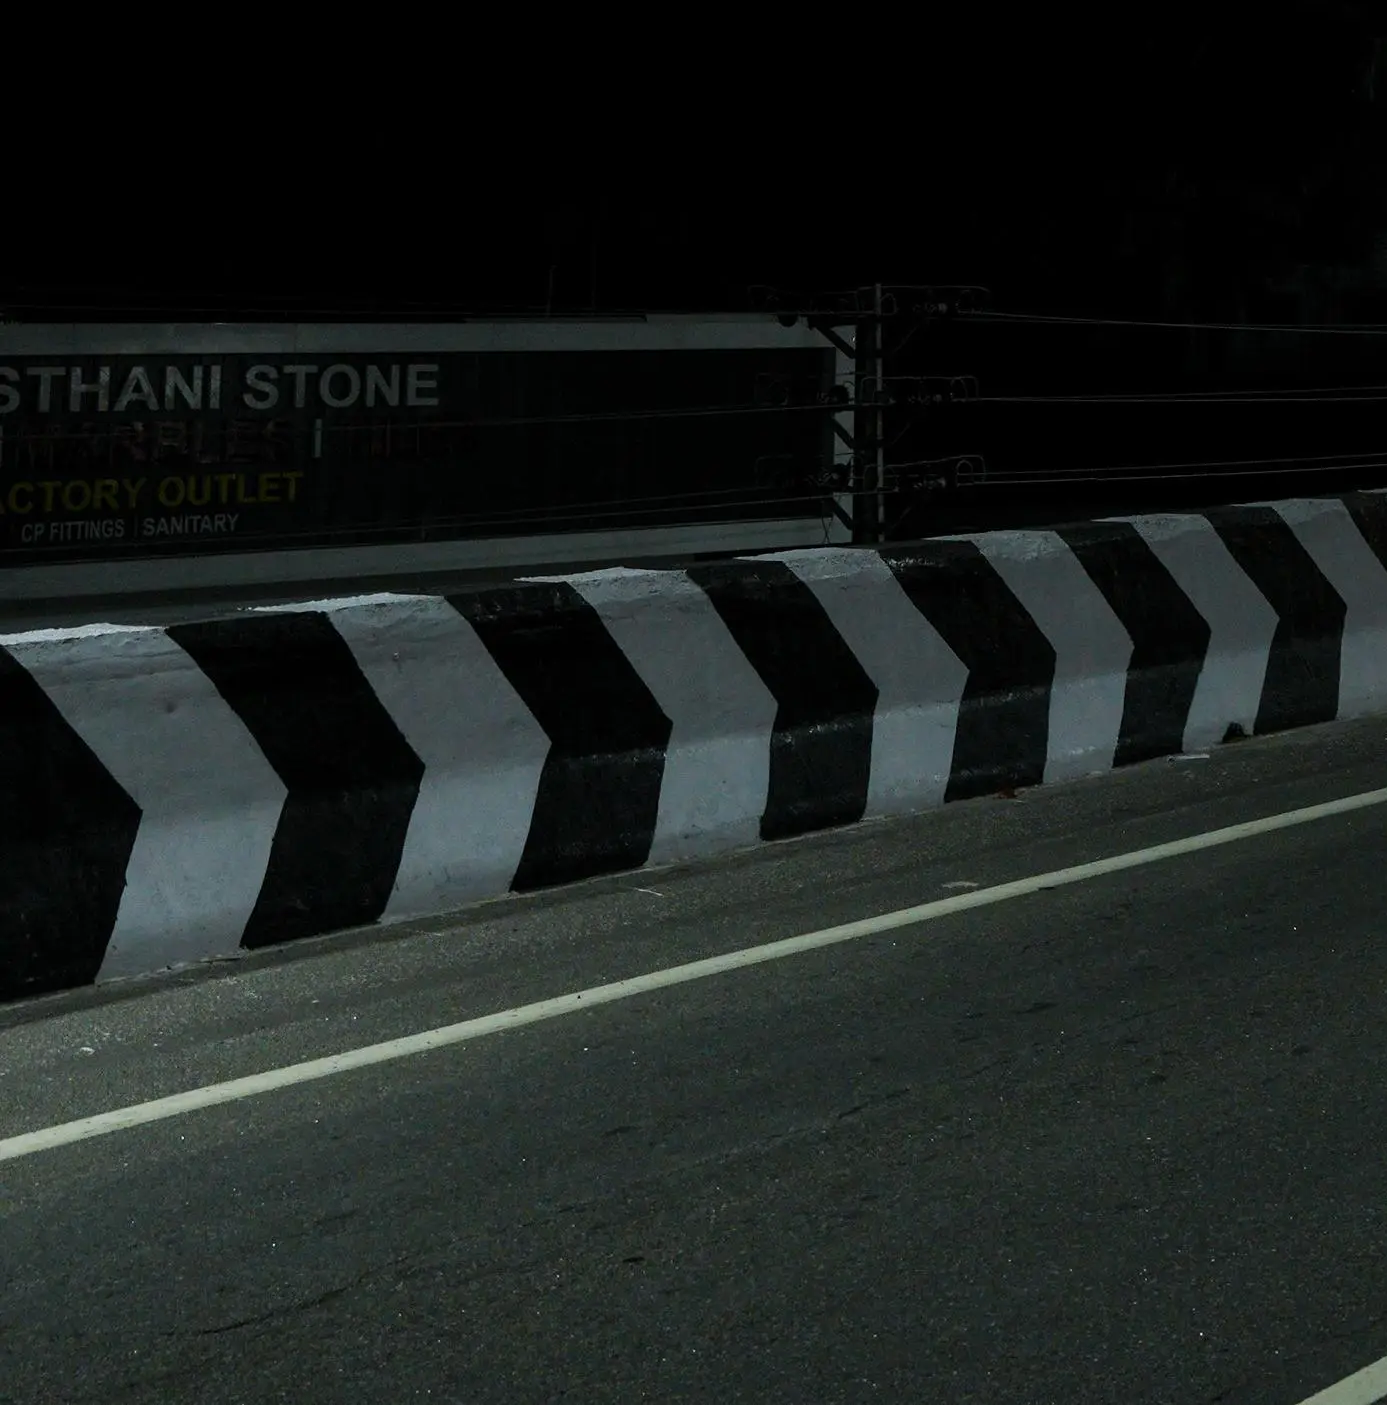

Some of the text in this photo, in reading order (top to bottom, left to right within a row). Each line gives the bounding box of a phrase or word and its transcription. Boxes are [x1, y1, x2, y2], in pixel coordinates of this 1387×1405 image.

[0, 363, 440, 415] STHANI STONE
[0, 469, 304, 515] CTORY OUTLET
[21, 513, 240, 543] CP FITTINGS SANITARY
